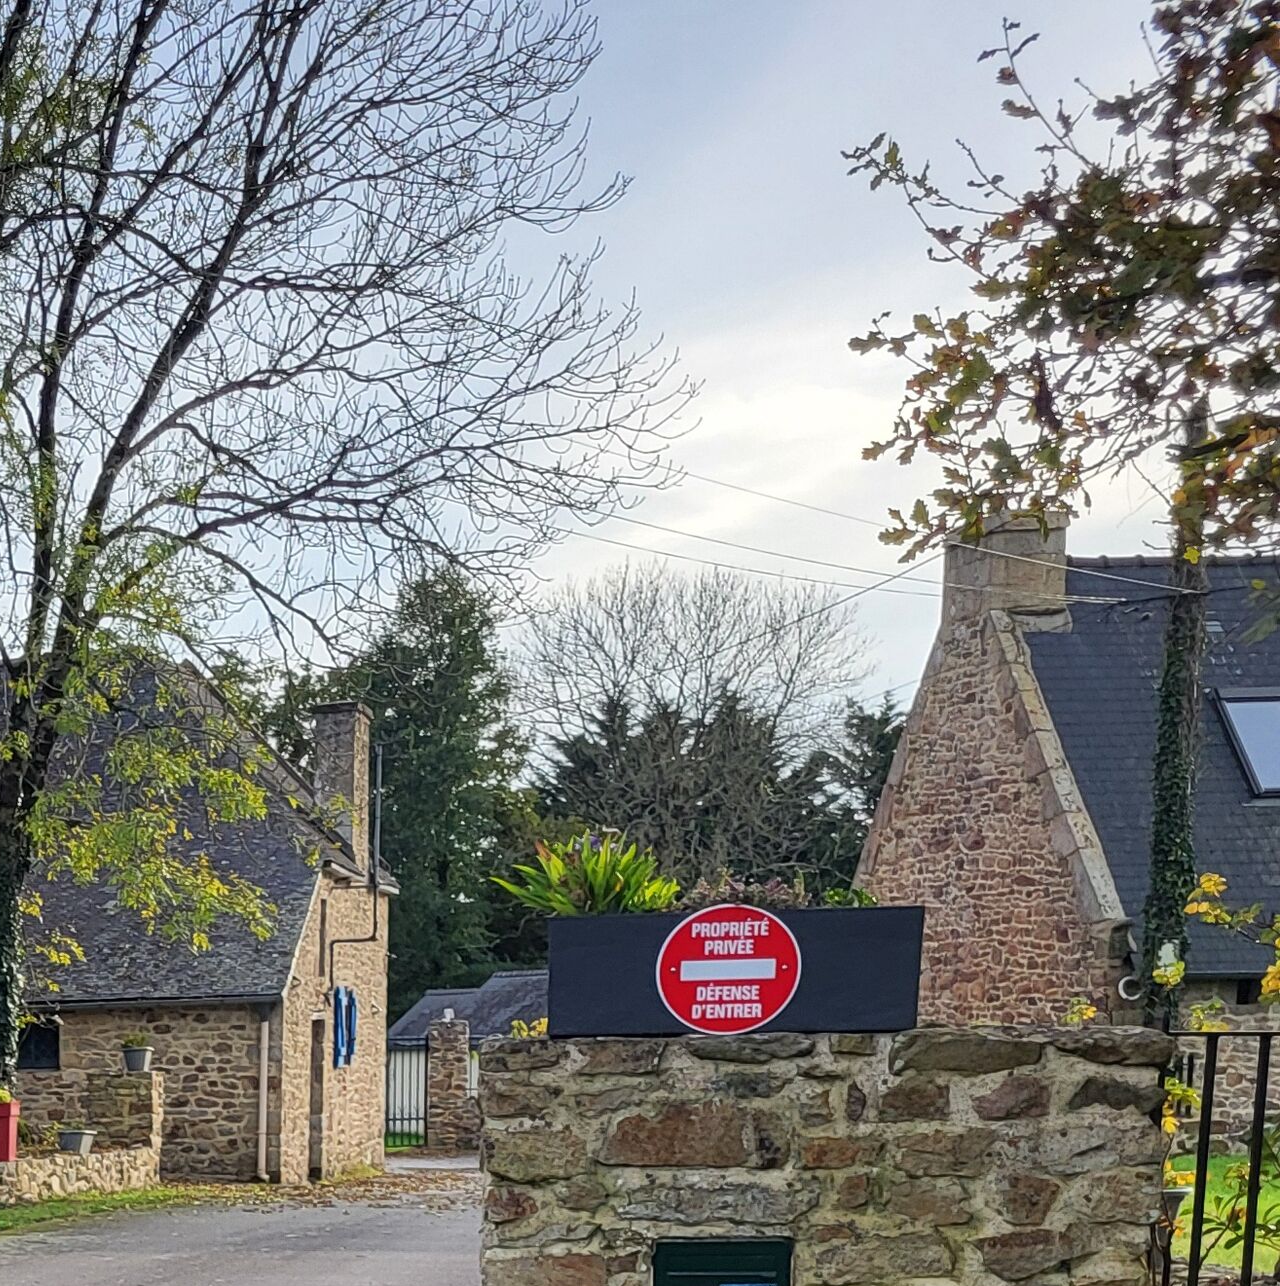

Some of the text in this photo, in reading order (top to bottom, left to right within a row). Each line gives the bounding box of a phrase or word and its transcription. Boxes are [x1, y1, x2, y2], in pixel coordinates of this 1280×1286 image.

[691, 917, 770, 938] PROPRIÉTÉ
[704, 936, 755, 956] PRIVÉE
[696, 982, 760, 1002] DÉFENSE
[691, 1003, 762, 1020] D'ENTRER
